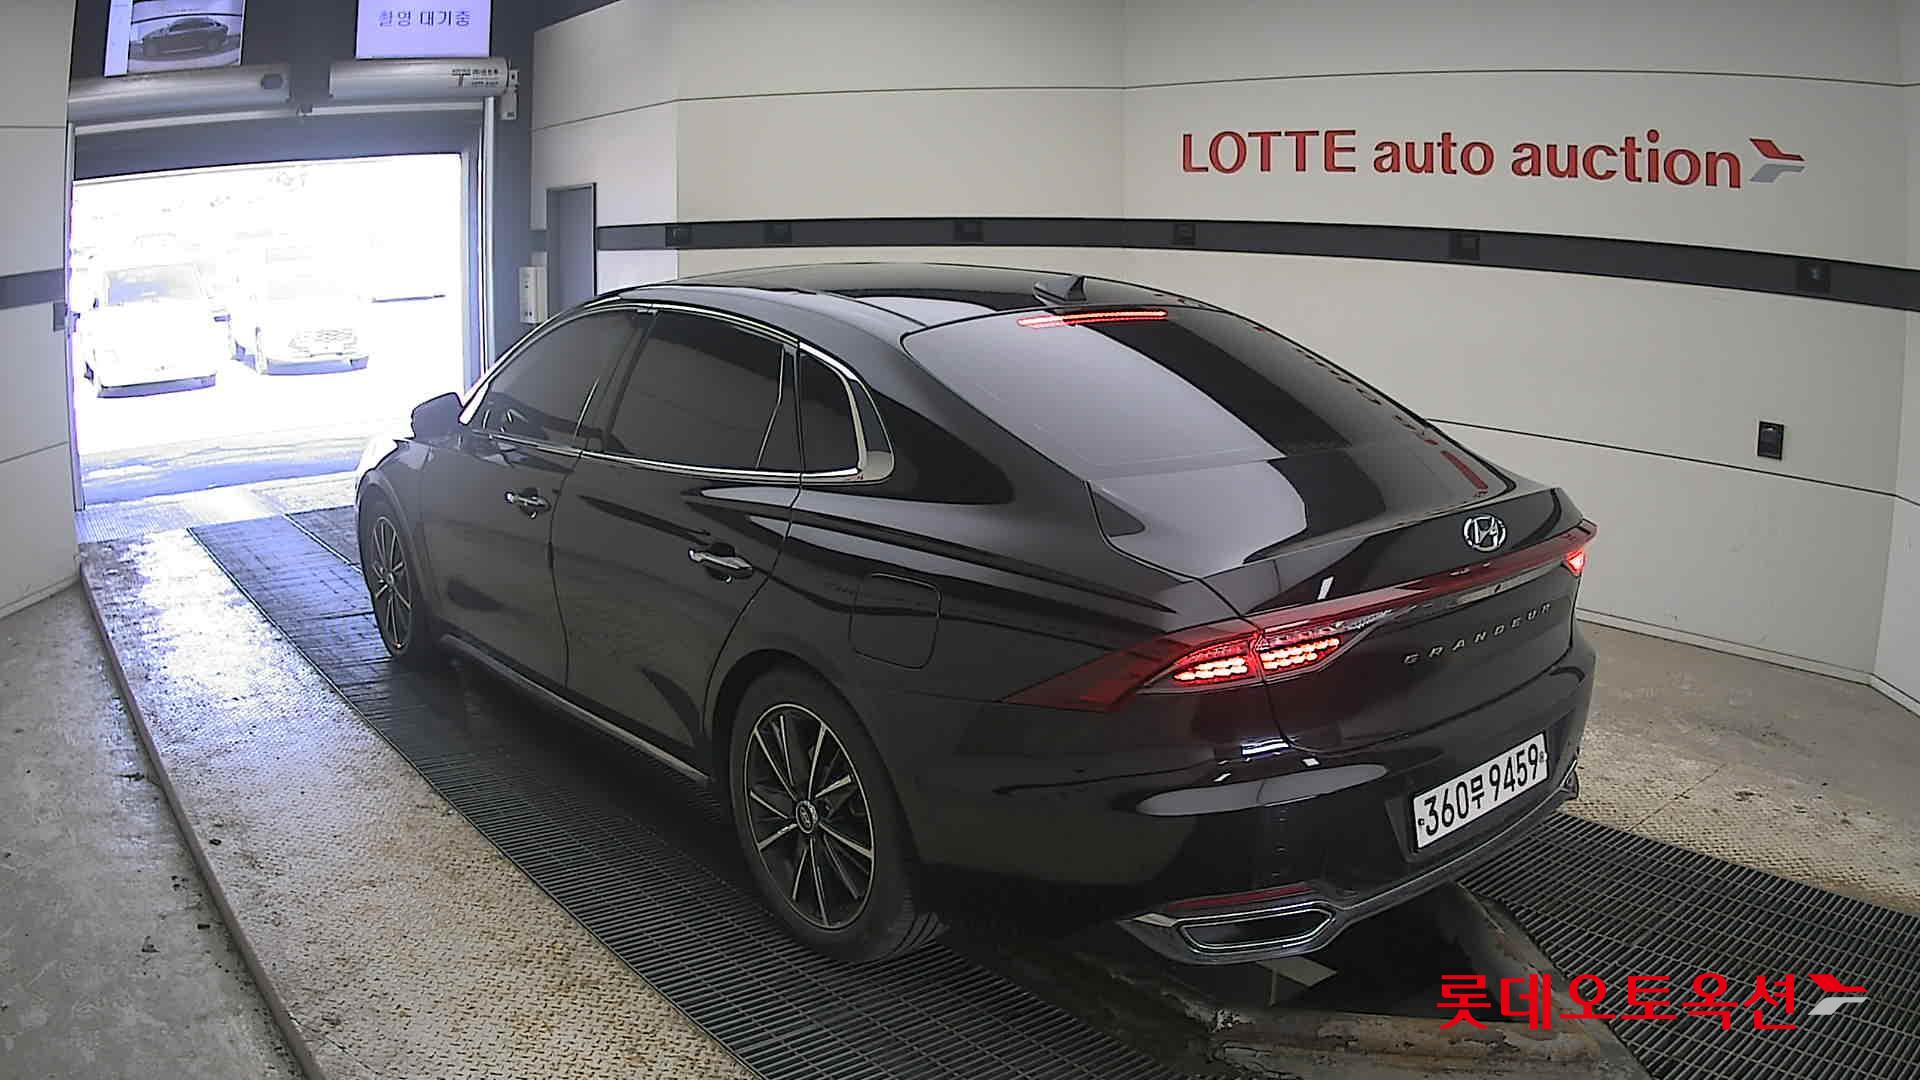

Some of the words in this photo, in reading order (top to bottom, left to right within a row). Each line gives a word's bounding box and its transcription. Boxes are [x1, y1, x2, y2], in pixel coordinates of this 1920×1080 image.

[420, 10, 470, 27] 대기중
[1181, 129, 1357, 174] LOTTE
[1373, 131, 1496, 175] auto
[1511, 128, 1742, 189] auction
[1403, 602, 1551, 665] GRANDEUR
